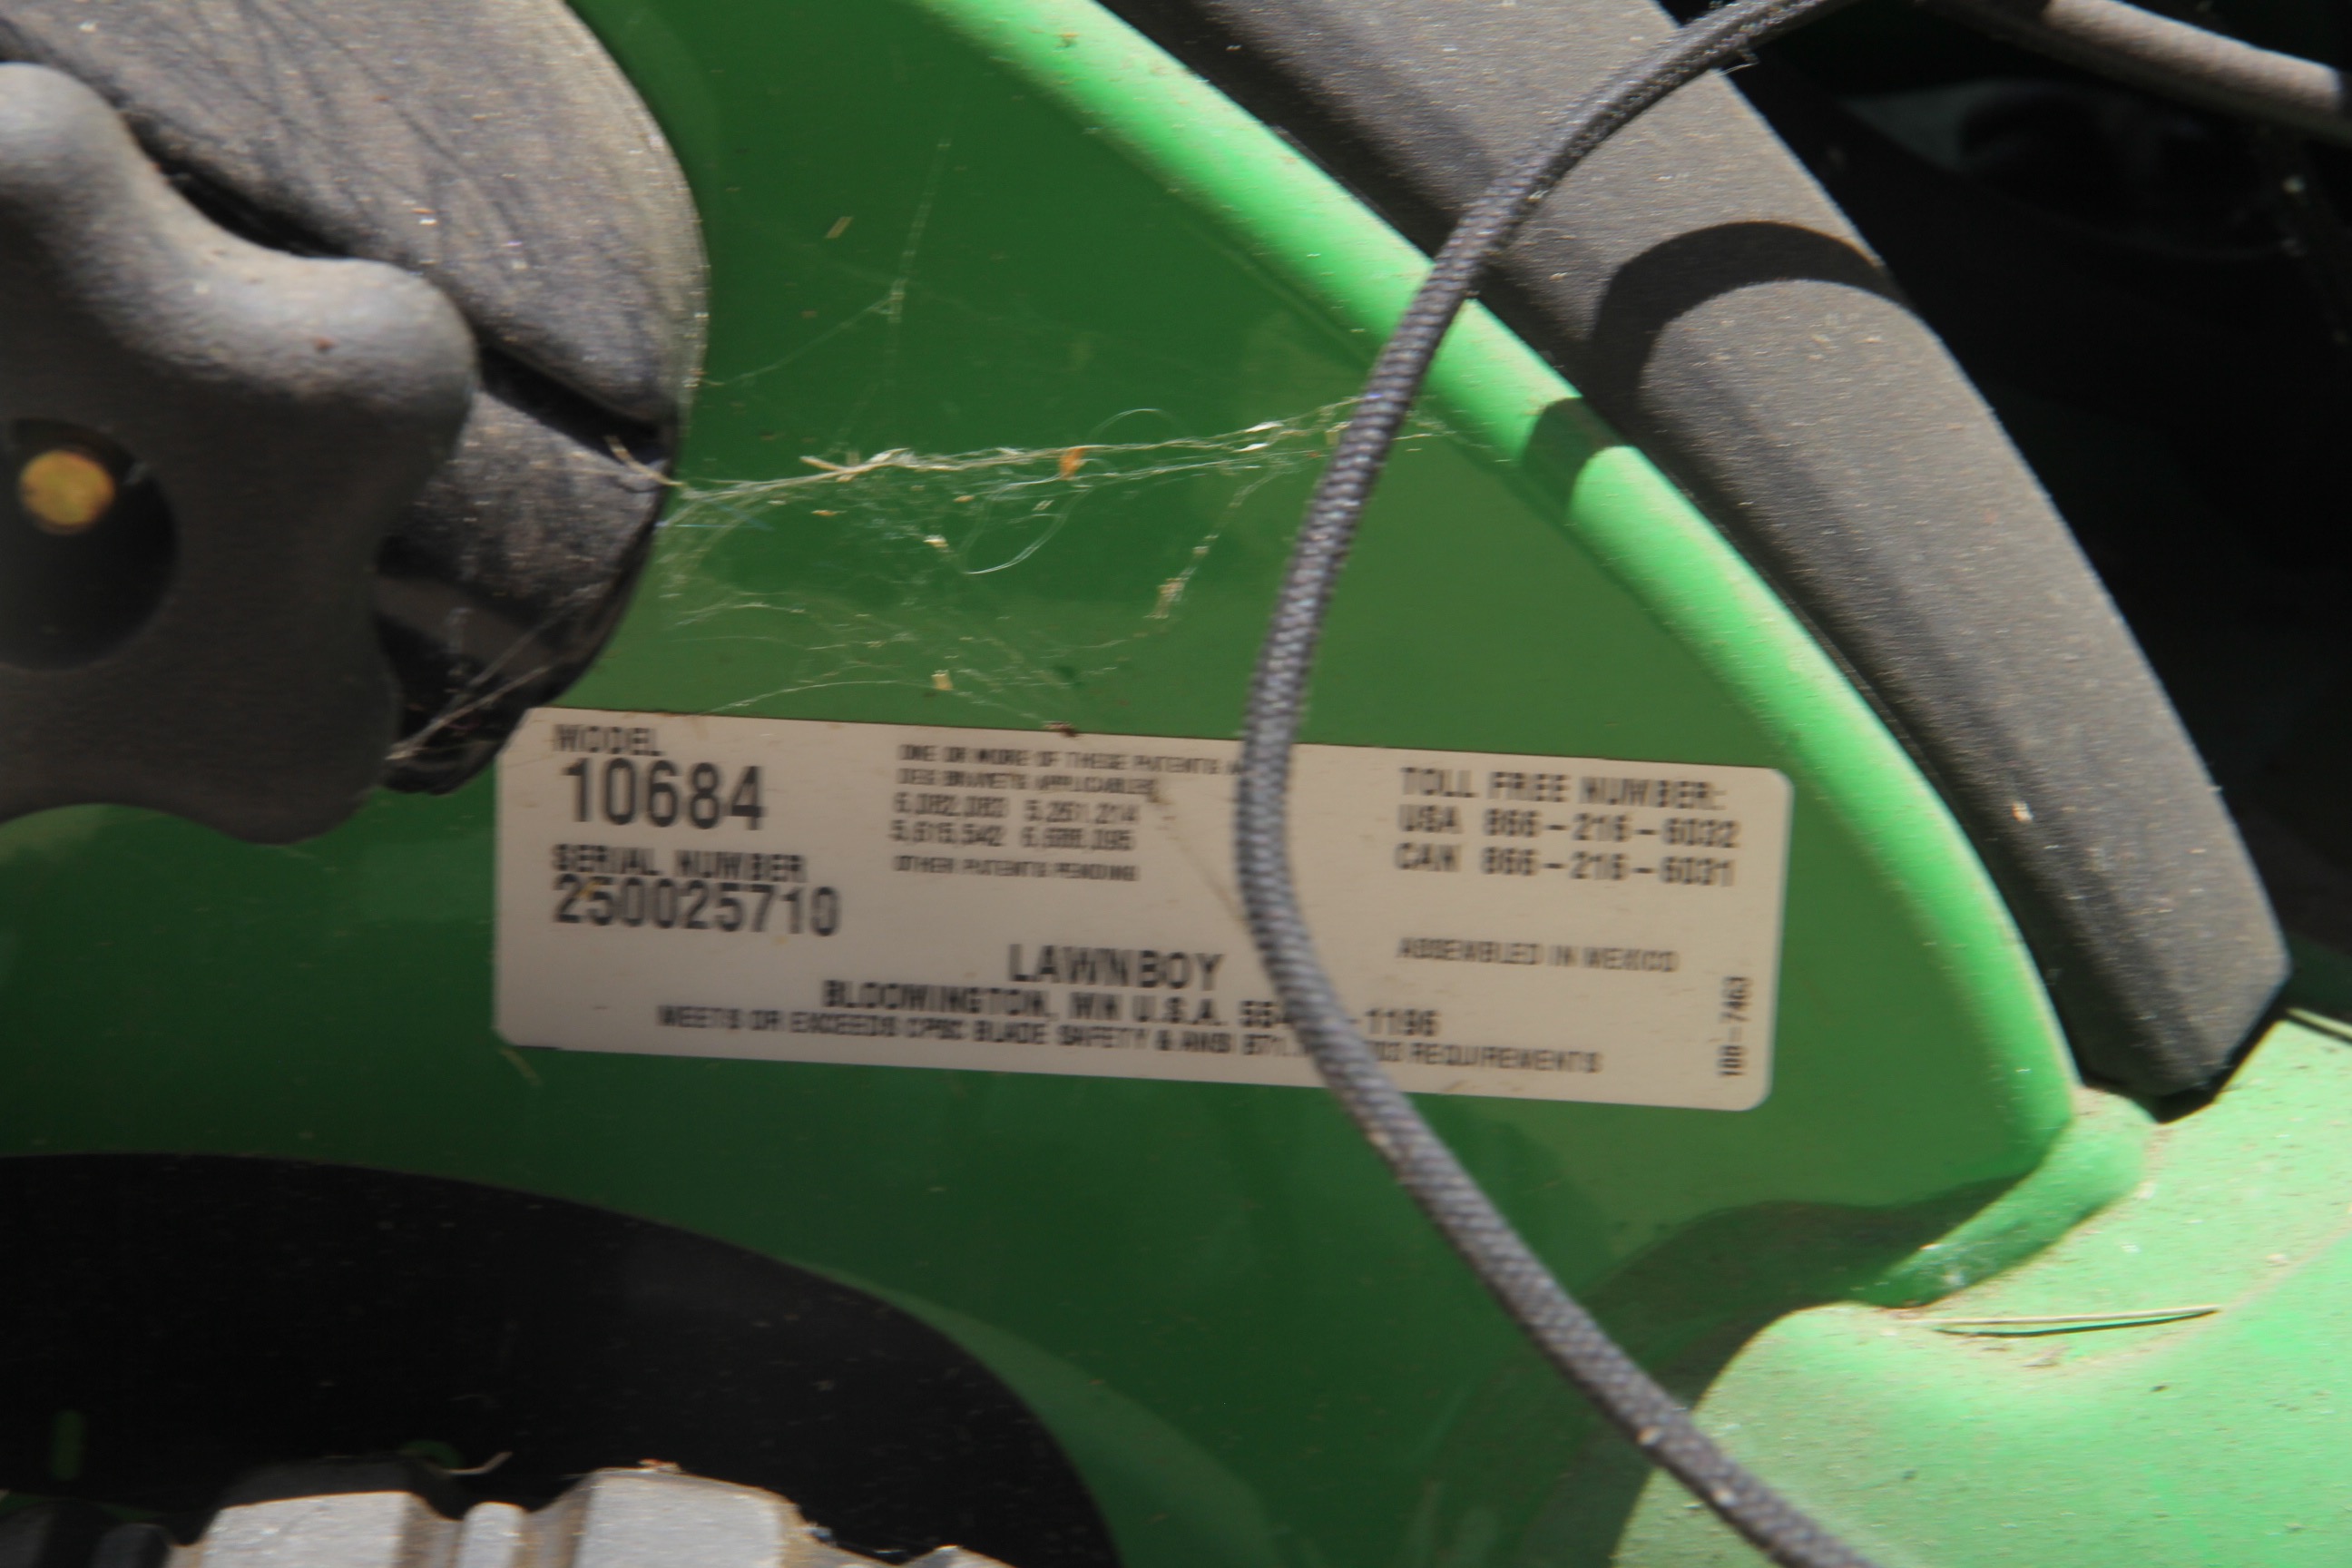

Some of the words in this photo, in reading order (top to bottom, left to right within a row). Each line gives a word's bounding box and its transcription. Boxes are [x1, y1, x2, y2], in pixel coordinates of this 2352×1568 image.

[554, 724, 665, 757] MODEL
[563, 758, 766, 830] 10684
[1399, 767, 1478, 799] TOLL
[1488, 771, 1571, 803] FREE
[1397, 804, 1463, 834] USA
[552, 843, 662, 877] SERIAL
[673, 849, 808, 883] NUMBER
[1395, 842, 1462, 873] CAN
[553, 873, 841, 936] 250025710
[1008, 944, 1225, 991] LAWNBOY
[1396, 937, 1540, 965] ASSEMBLED
[1547, 945, 1577, 967] IN
[1583, 946, 1680, 972] MEXICO
[657, 1004, 741, 1031] MEETS
[750, 1008, 783, 1032] OR
[789, 1011, 897, 1037] EXCEEDS
[974, 1019, 1050, 1044] BLADE
[1057, 1023, 1148, 1049] SAFETY
[1410, 1041, 1604, 1073] REQUIREMENTS
